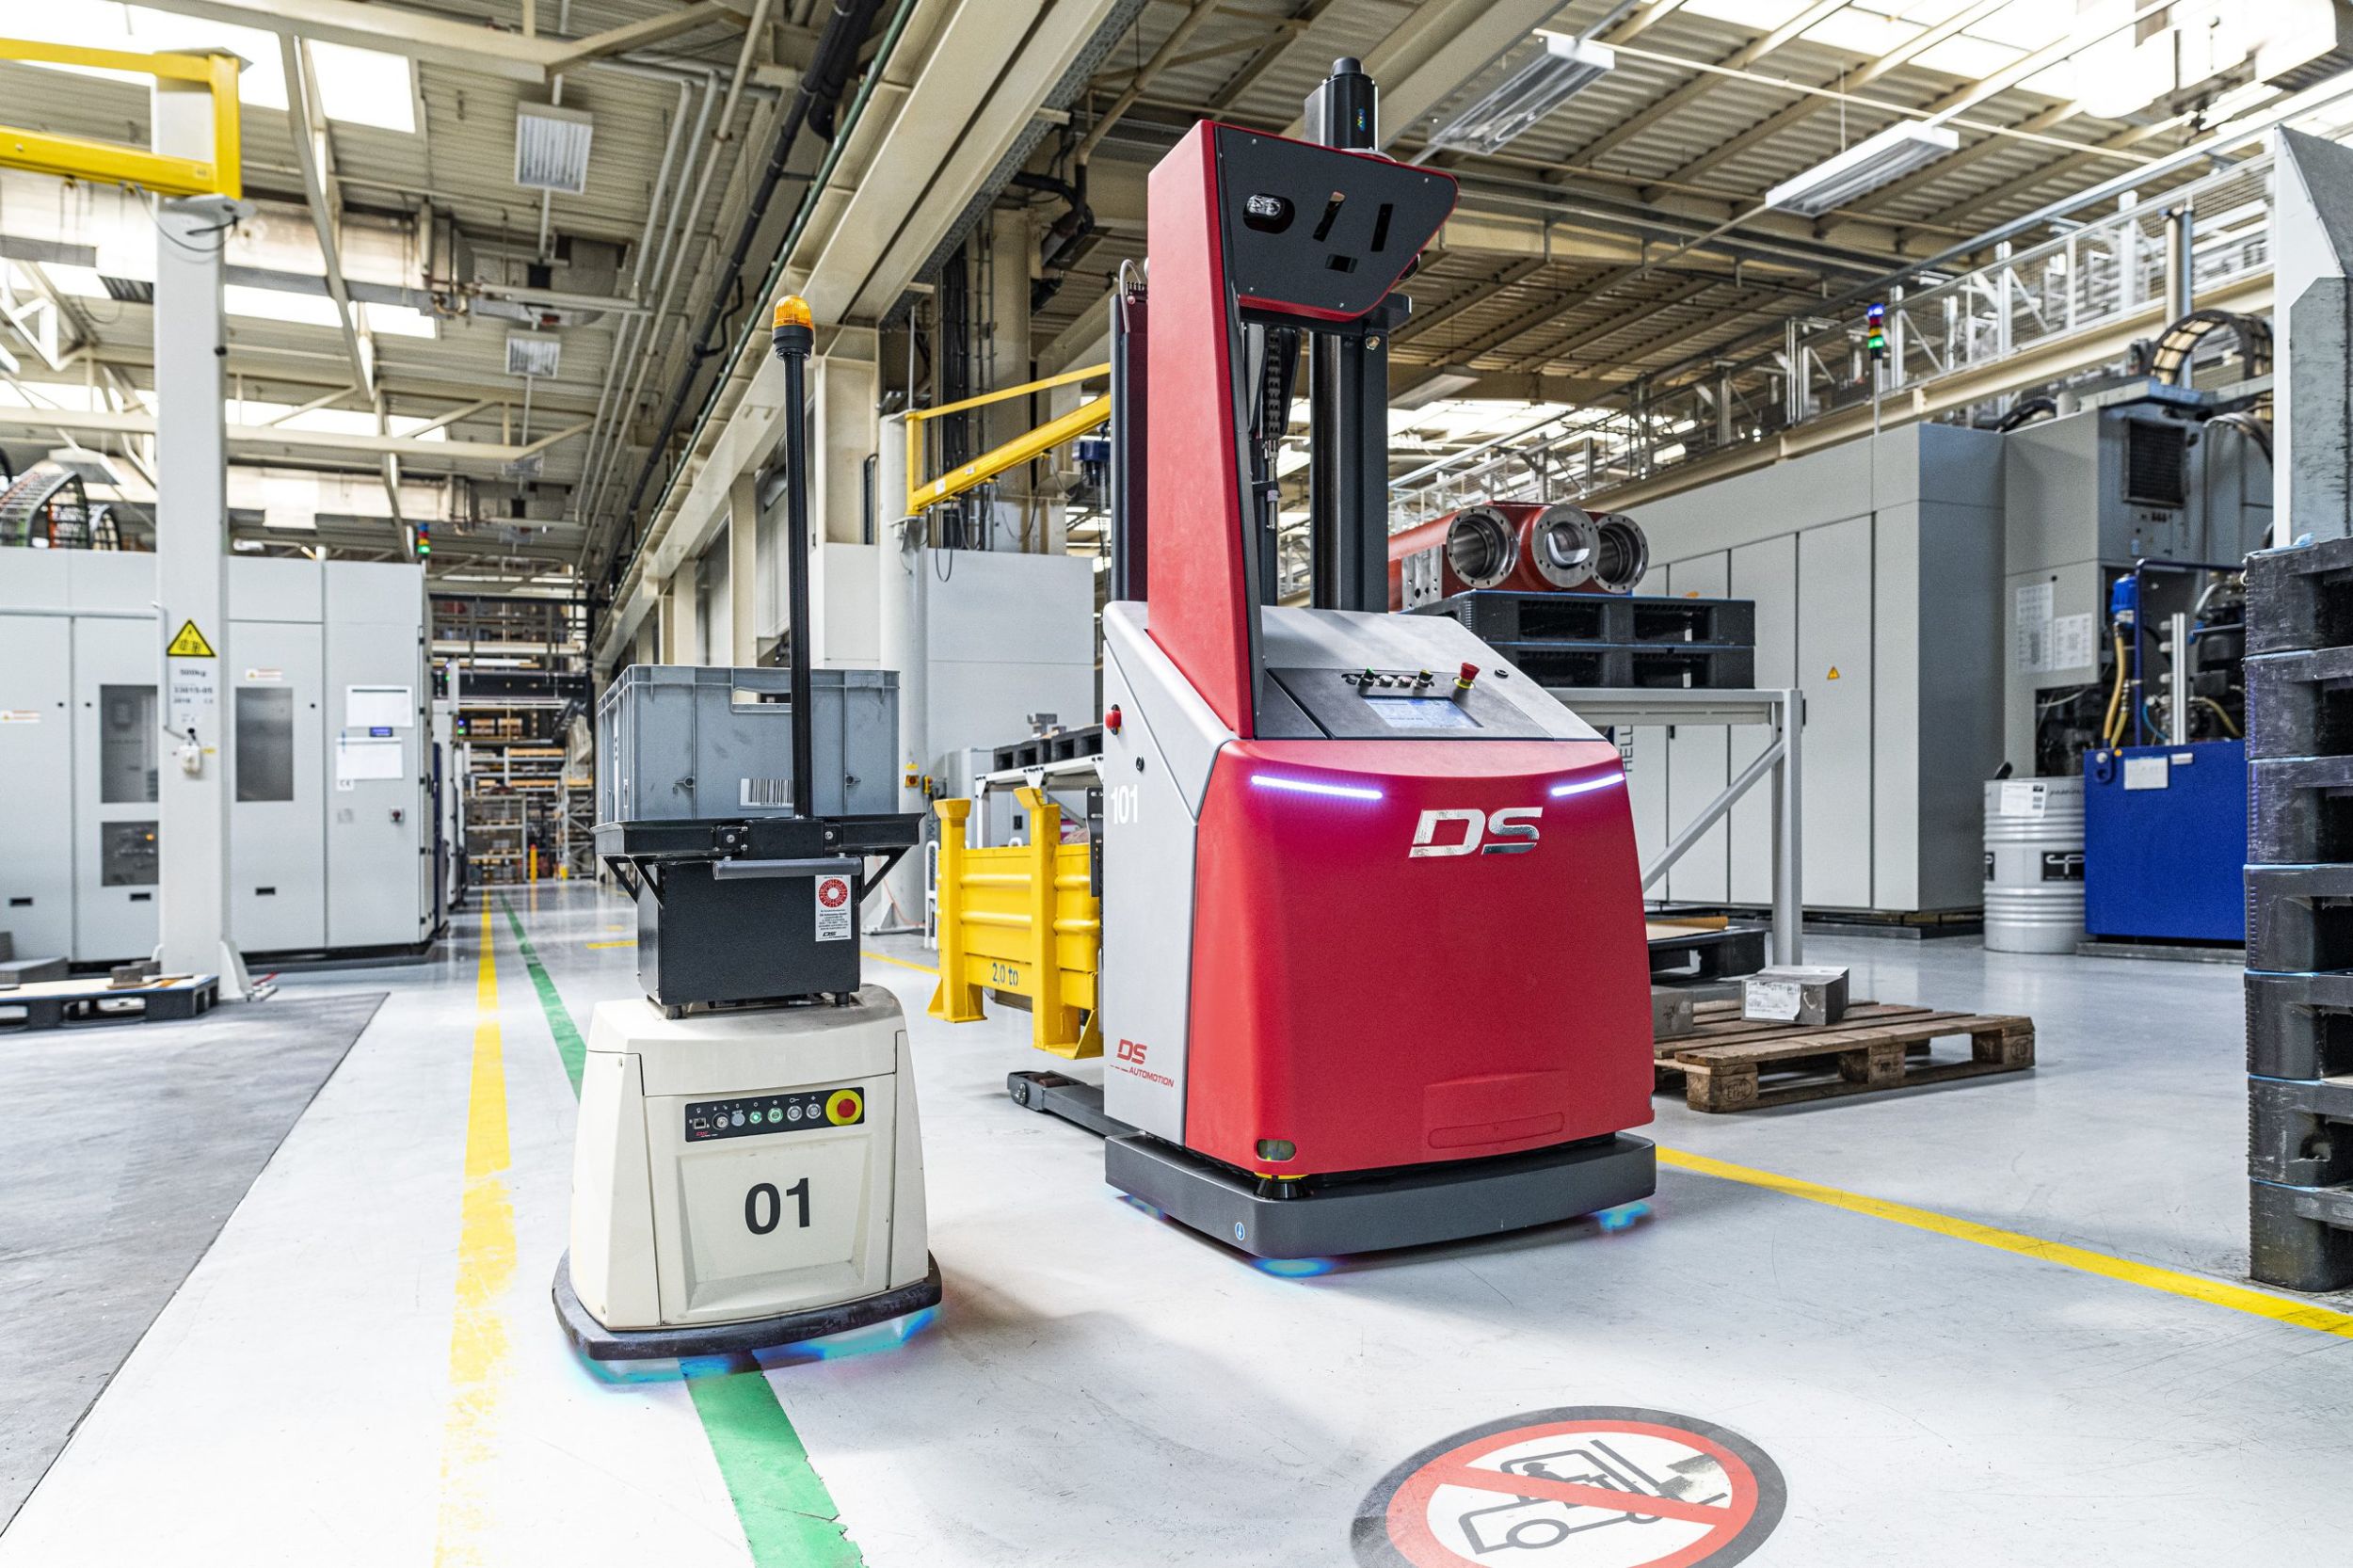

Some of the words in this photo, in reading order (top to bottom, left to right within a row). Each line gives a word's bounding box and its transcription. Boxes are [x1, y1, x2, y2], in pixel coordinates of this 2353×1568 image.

[1111, 783, 1138, 824] 101
[1408, 807, 1543, 858] DS
[1117, 1039, 1147, 1064] DS
[1129, 1066, 1175, 1088] AUTOMOTION
[744, 1176, 810, 1235] 01
